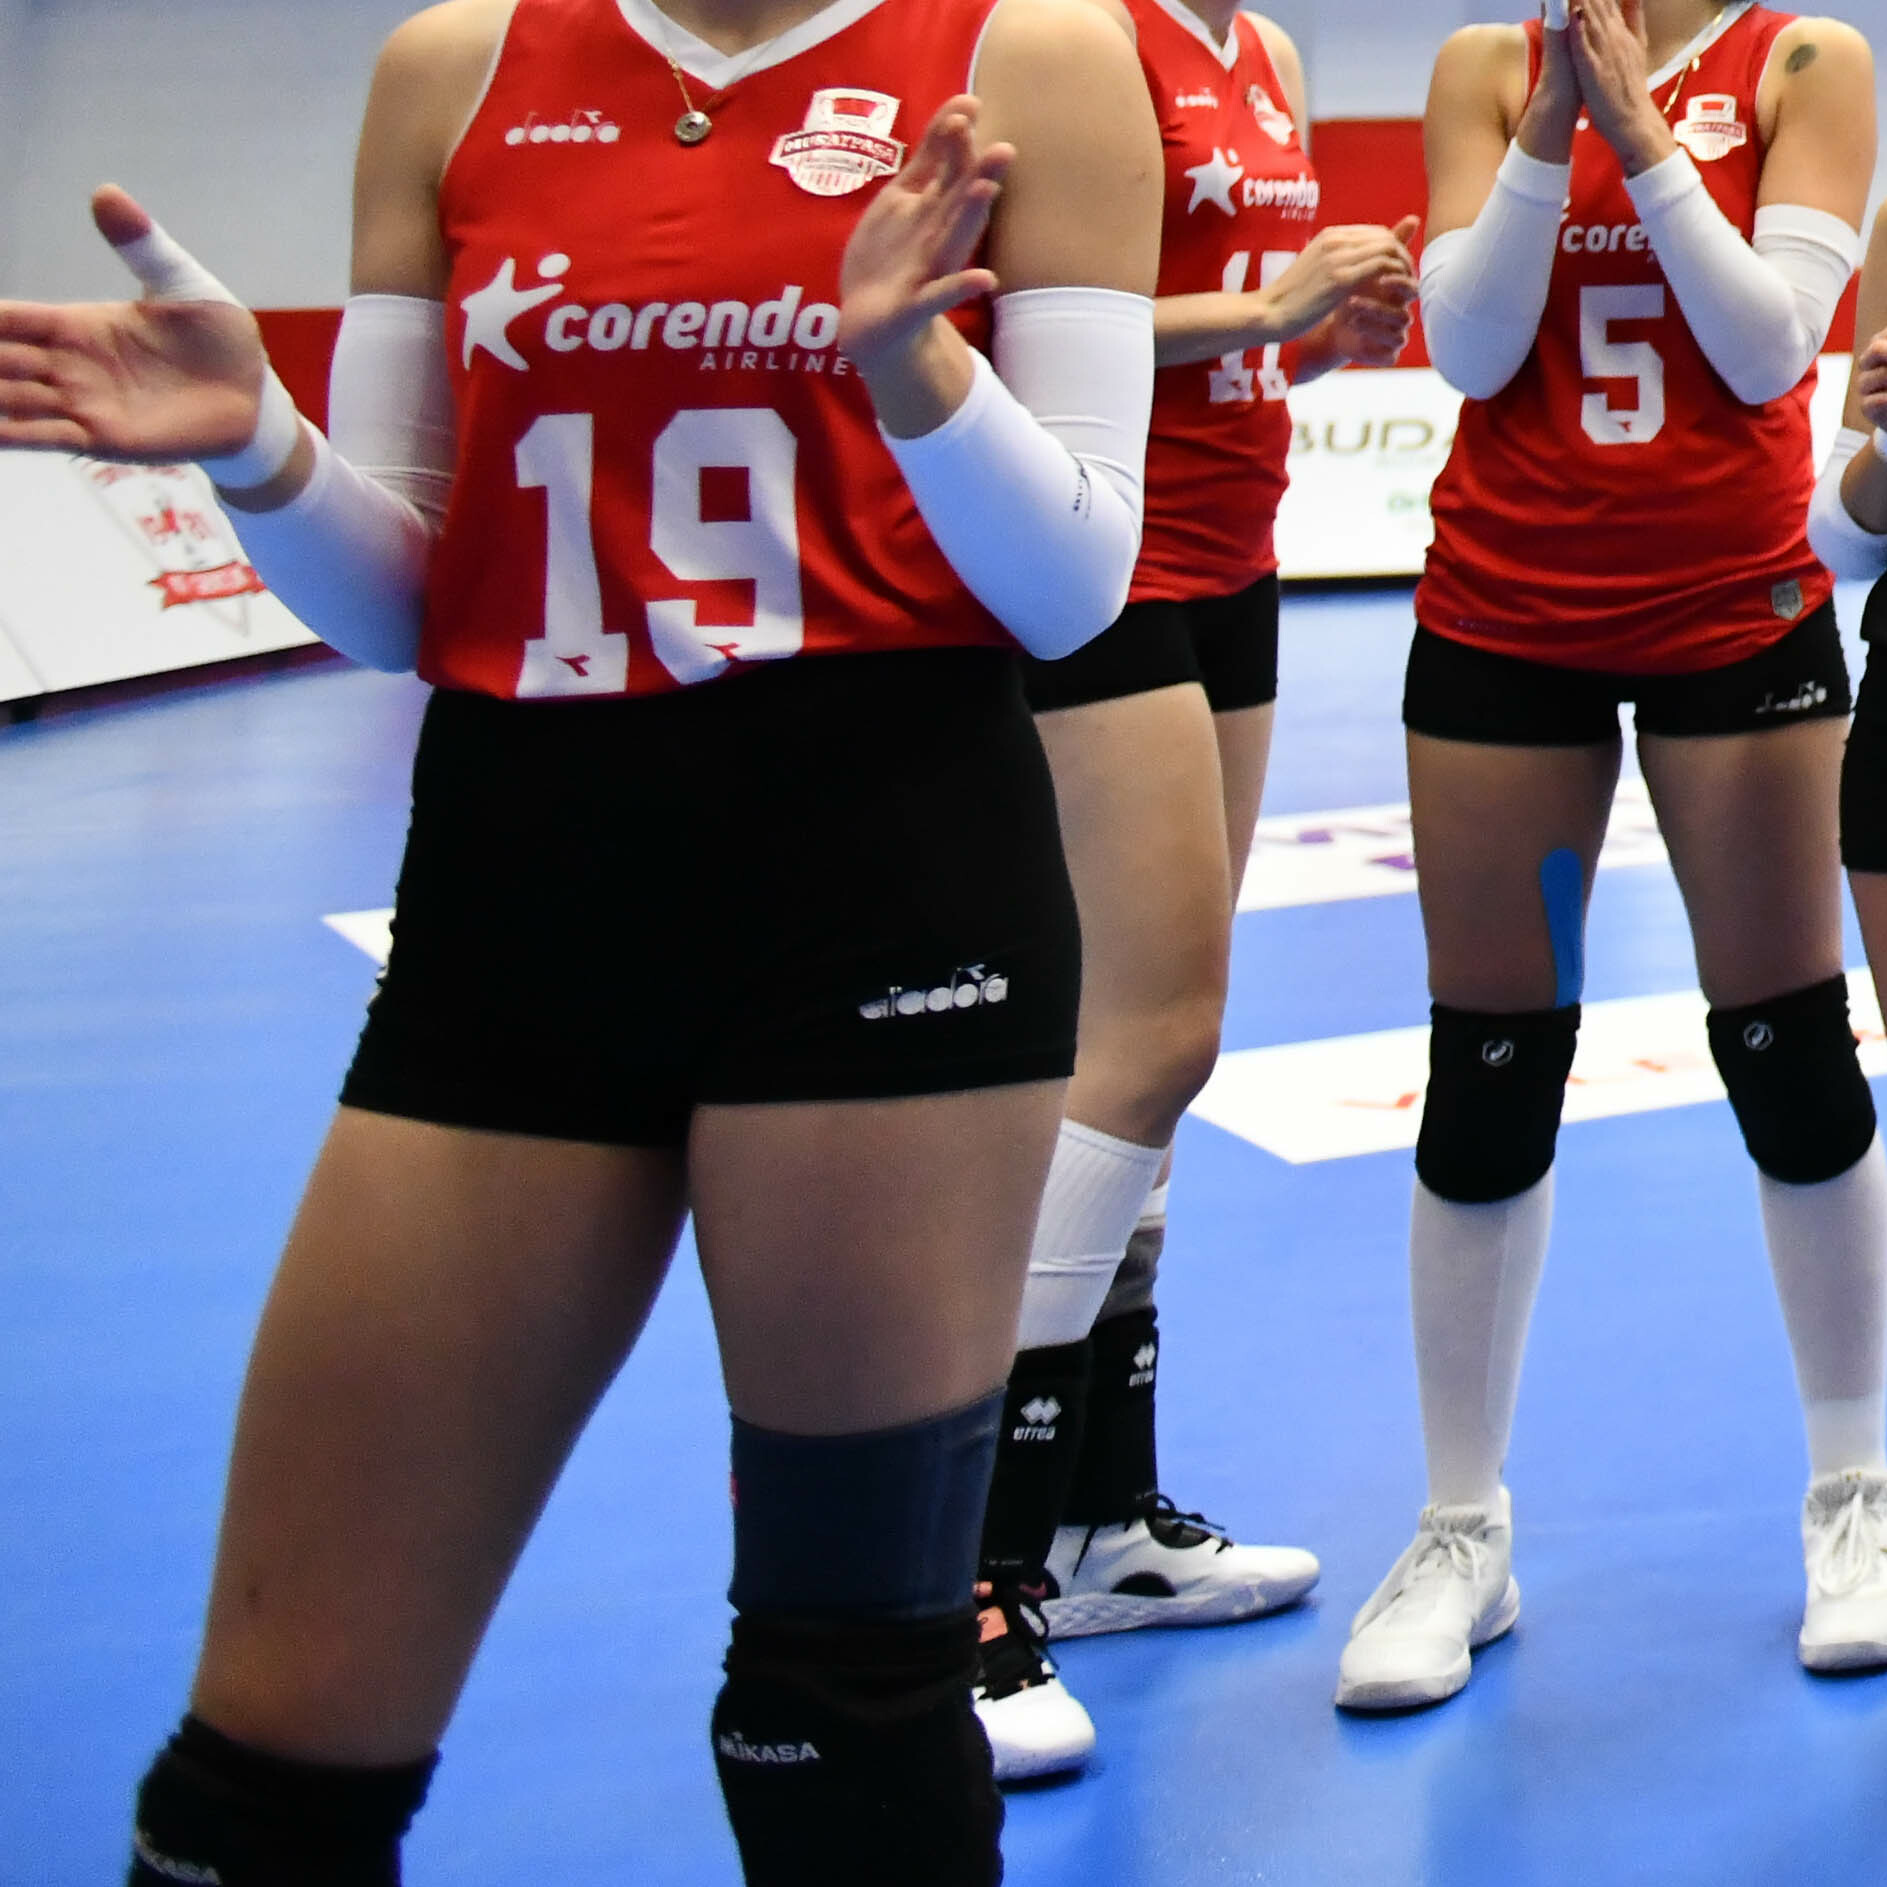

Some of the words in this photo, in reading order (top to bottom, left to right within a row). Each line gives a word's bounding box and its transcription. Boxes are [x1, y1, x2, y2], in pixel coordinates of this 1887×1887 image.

[545, 285, 845, 352] corendo
[700, 350, 862, 377] AIRLINE
[1579, 284, 1665, 445] 5
[514, 409, 804, 698] 19
